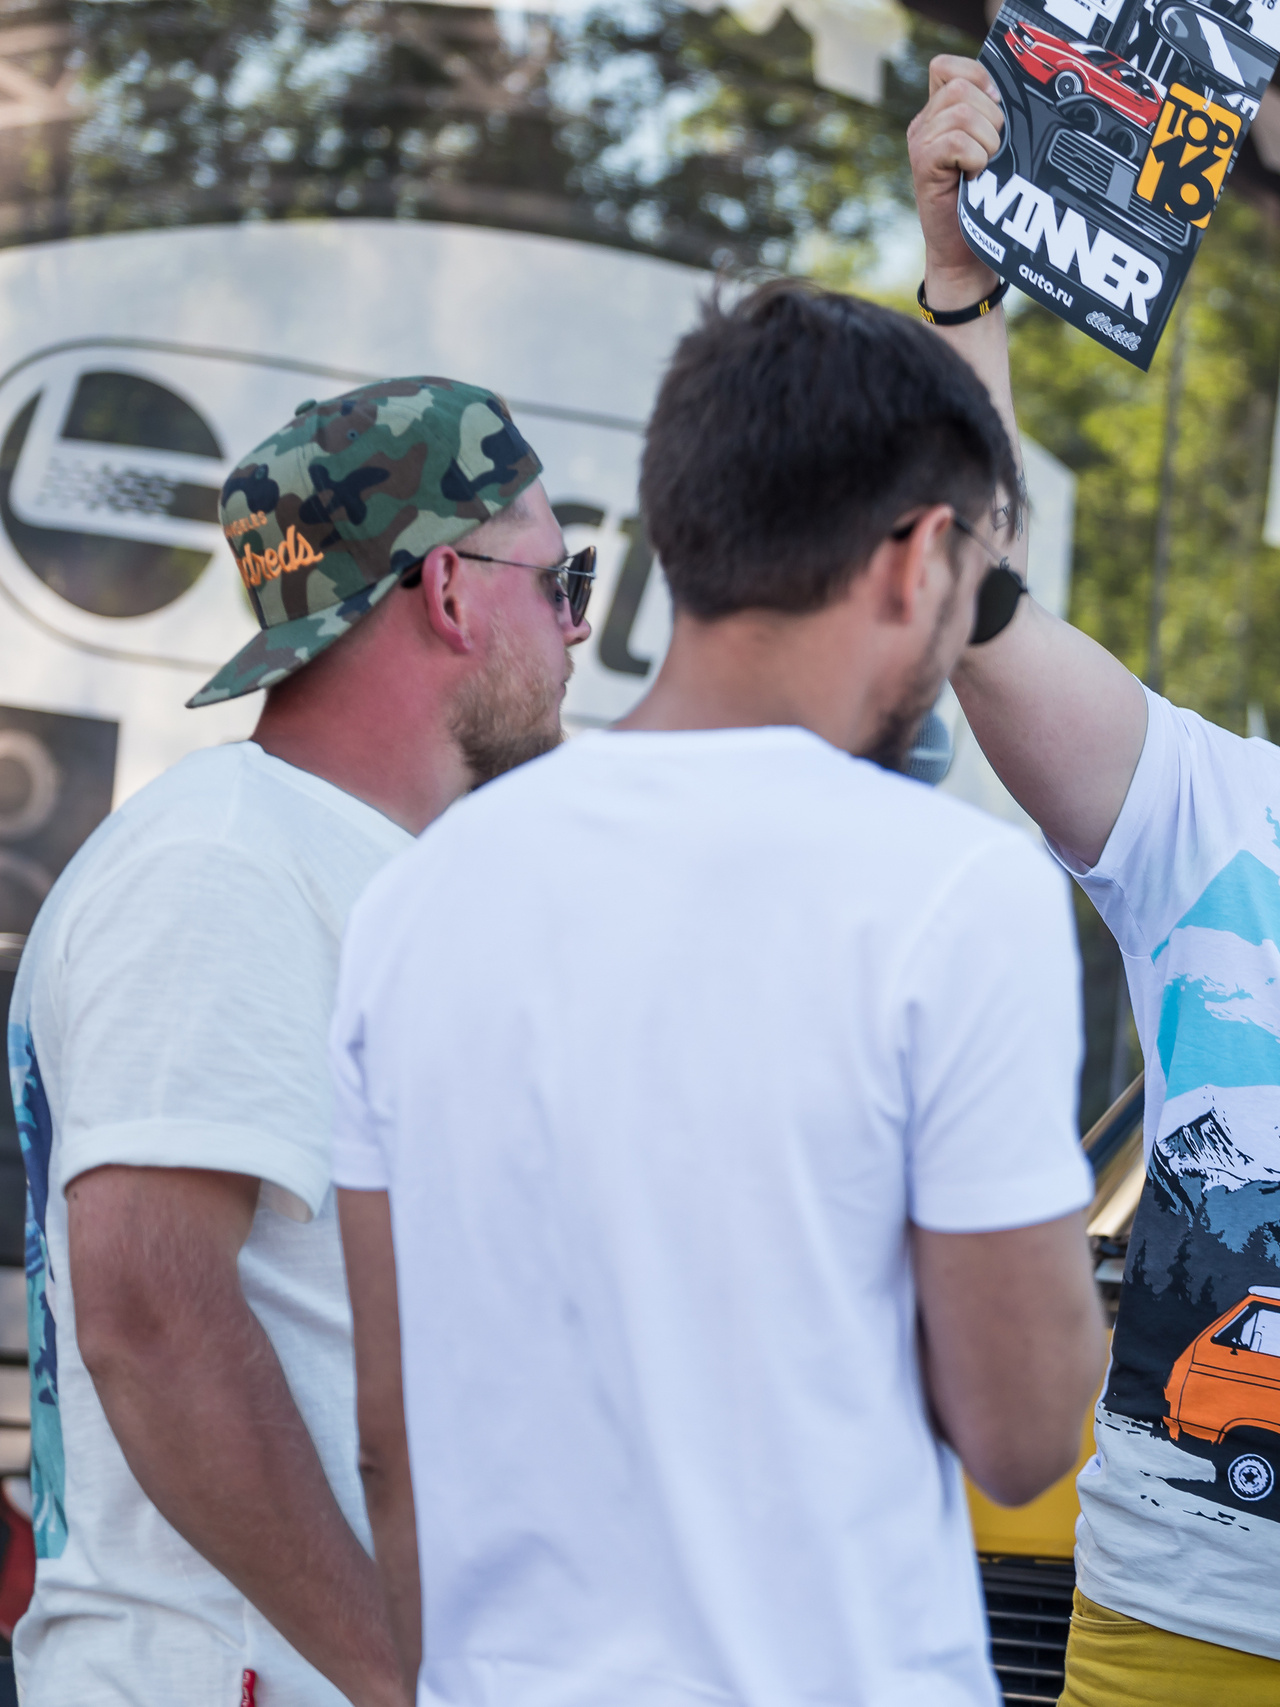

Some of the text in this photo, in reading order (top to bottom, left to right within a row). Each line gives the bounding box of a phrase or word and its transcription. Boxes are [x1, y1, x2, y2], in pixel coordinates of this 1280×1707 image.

[1166, 95, 1235, 150] TOP
[1151, 135, 1223, 221] 16
[968, 168, 1163, 326] WINNER
[1018, 263, 1074, 309] auto.ru
